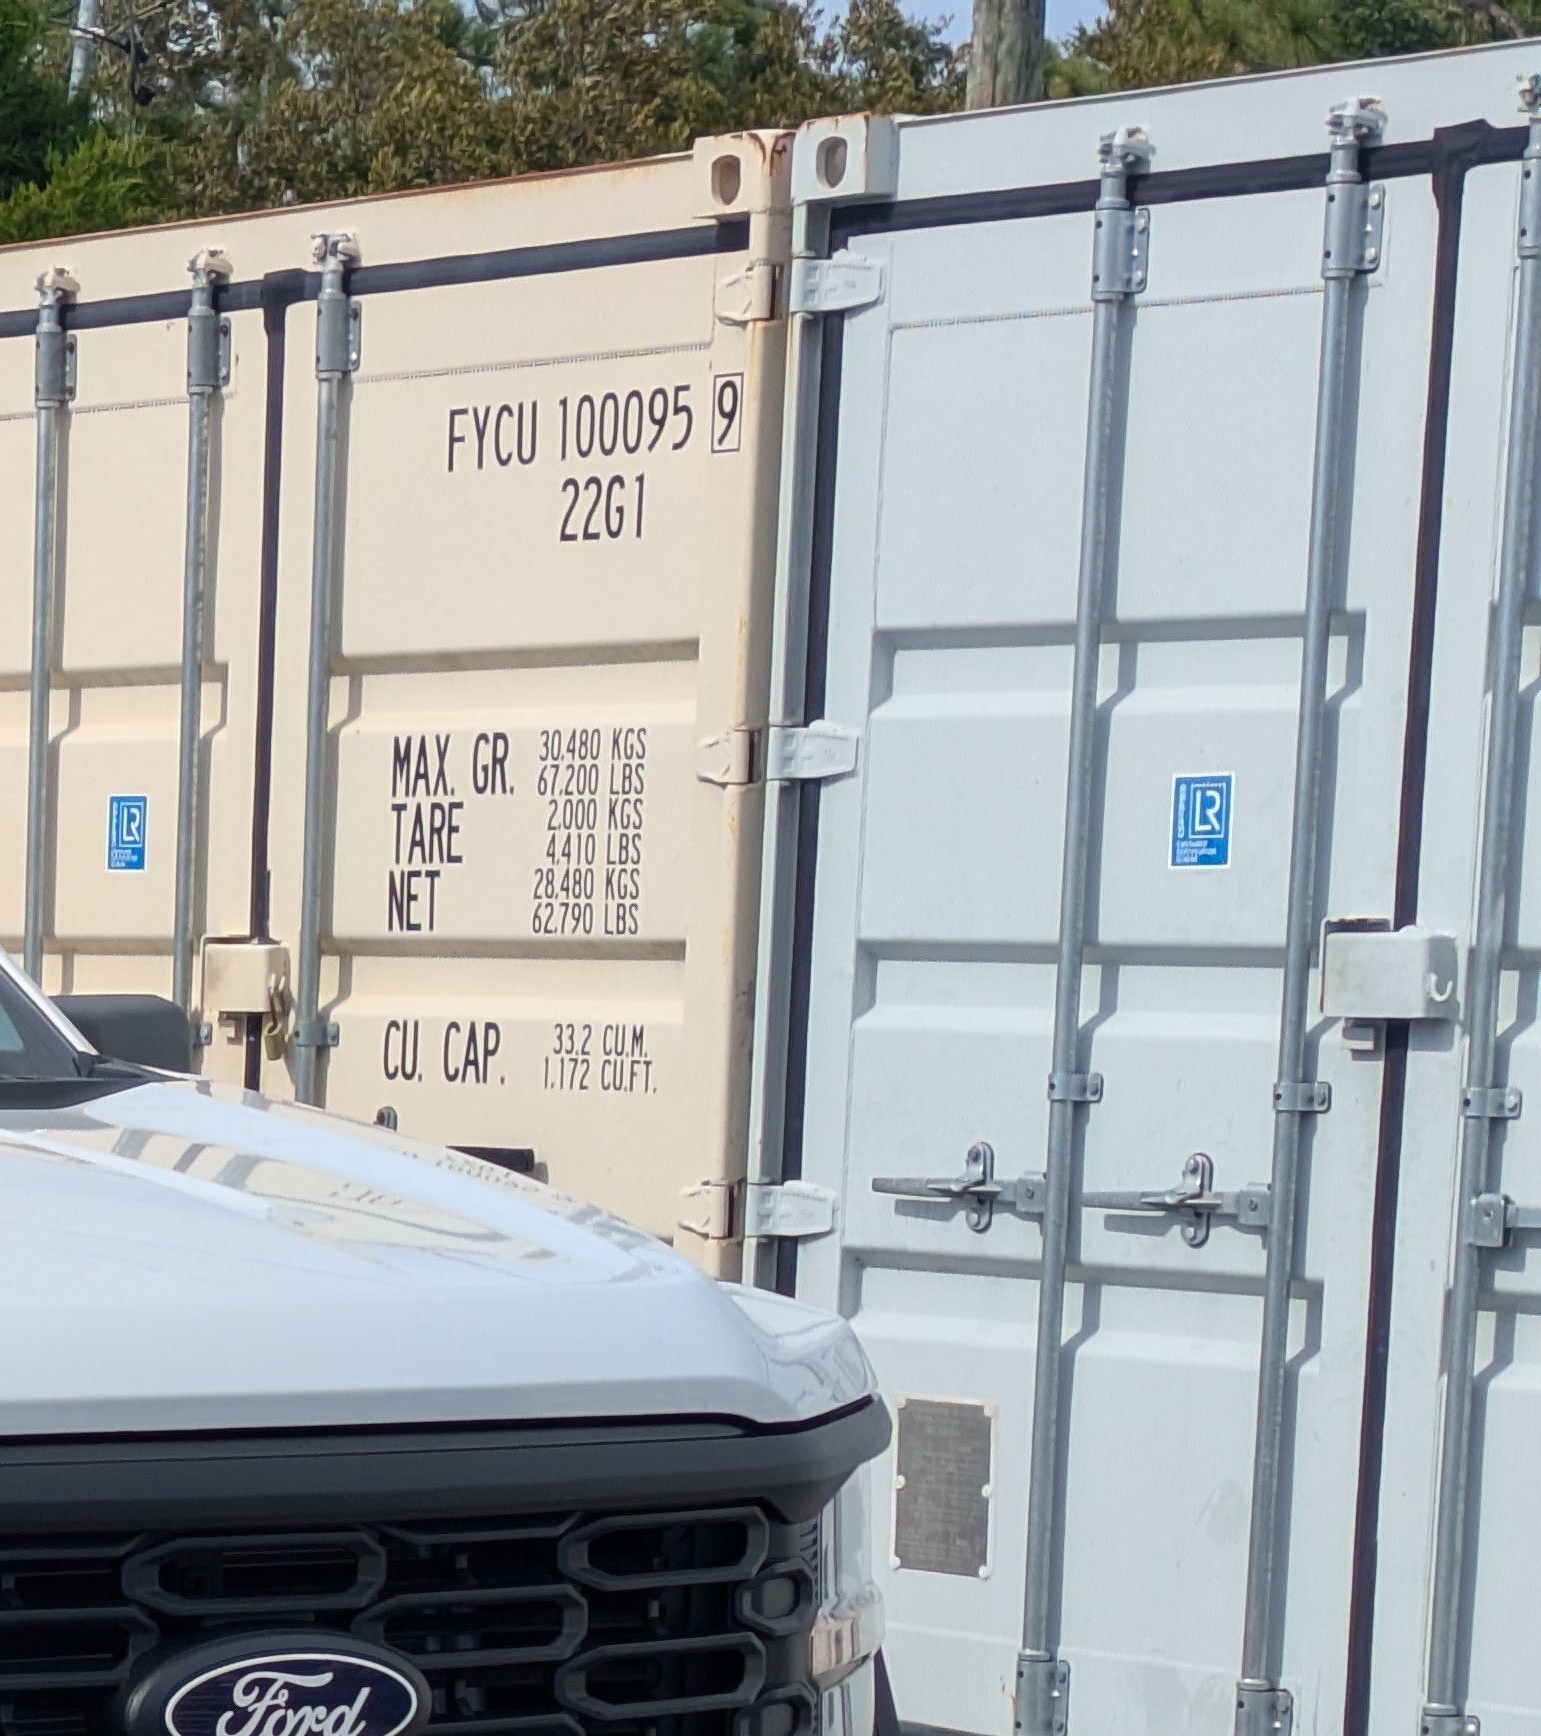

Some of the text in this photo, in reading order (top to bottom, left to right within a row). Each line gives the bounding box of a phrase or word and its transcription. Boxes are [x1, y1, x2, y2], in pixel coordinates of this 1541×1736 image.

[447, 380, 739, 473] FYCU 100095 9
[559, 473, 645, 542] 22G1
[539, 727, 647, 761] 30.480 KGS
[392, 732, 515, 798] MAX. GR.
[537, 763, 645, 796] 67.200 LBS
[123, 806, 140, 842] LR
[547, 796, 643, 831] 2.000 KGS
[1195, 790, 1221, 832] LR
[391, 801, 464, 865] TARE
[546, 832, 642, 865] 4.410 LBS
[388, 869, 440, 932] NET
[533, 867, 640, 900] 28.480 KGS
[532, 902, 639, 935] 62.790 LBS
[383, 1019, 506, 1086] CU. CAP.
[553, 1023, 648, 1058] 33.2 CU.M.
[544, 1056, 590, 1091] 1.172
